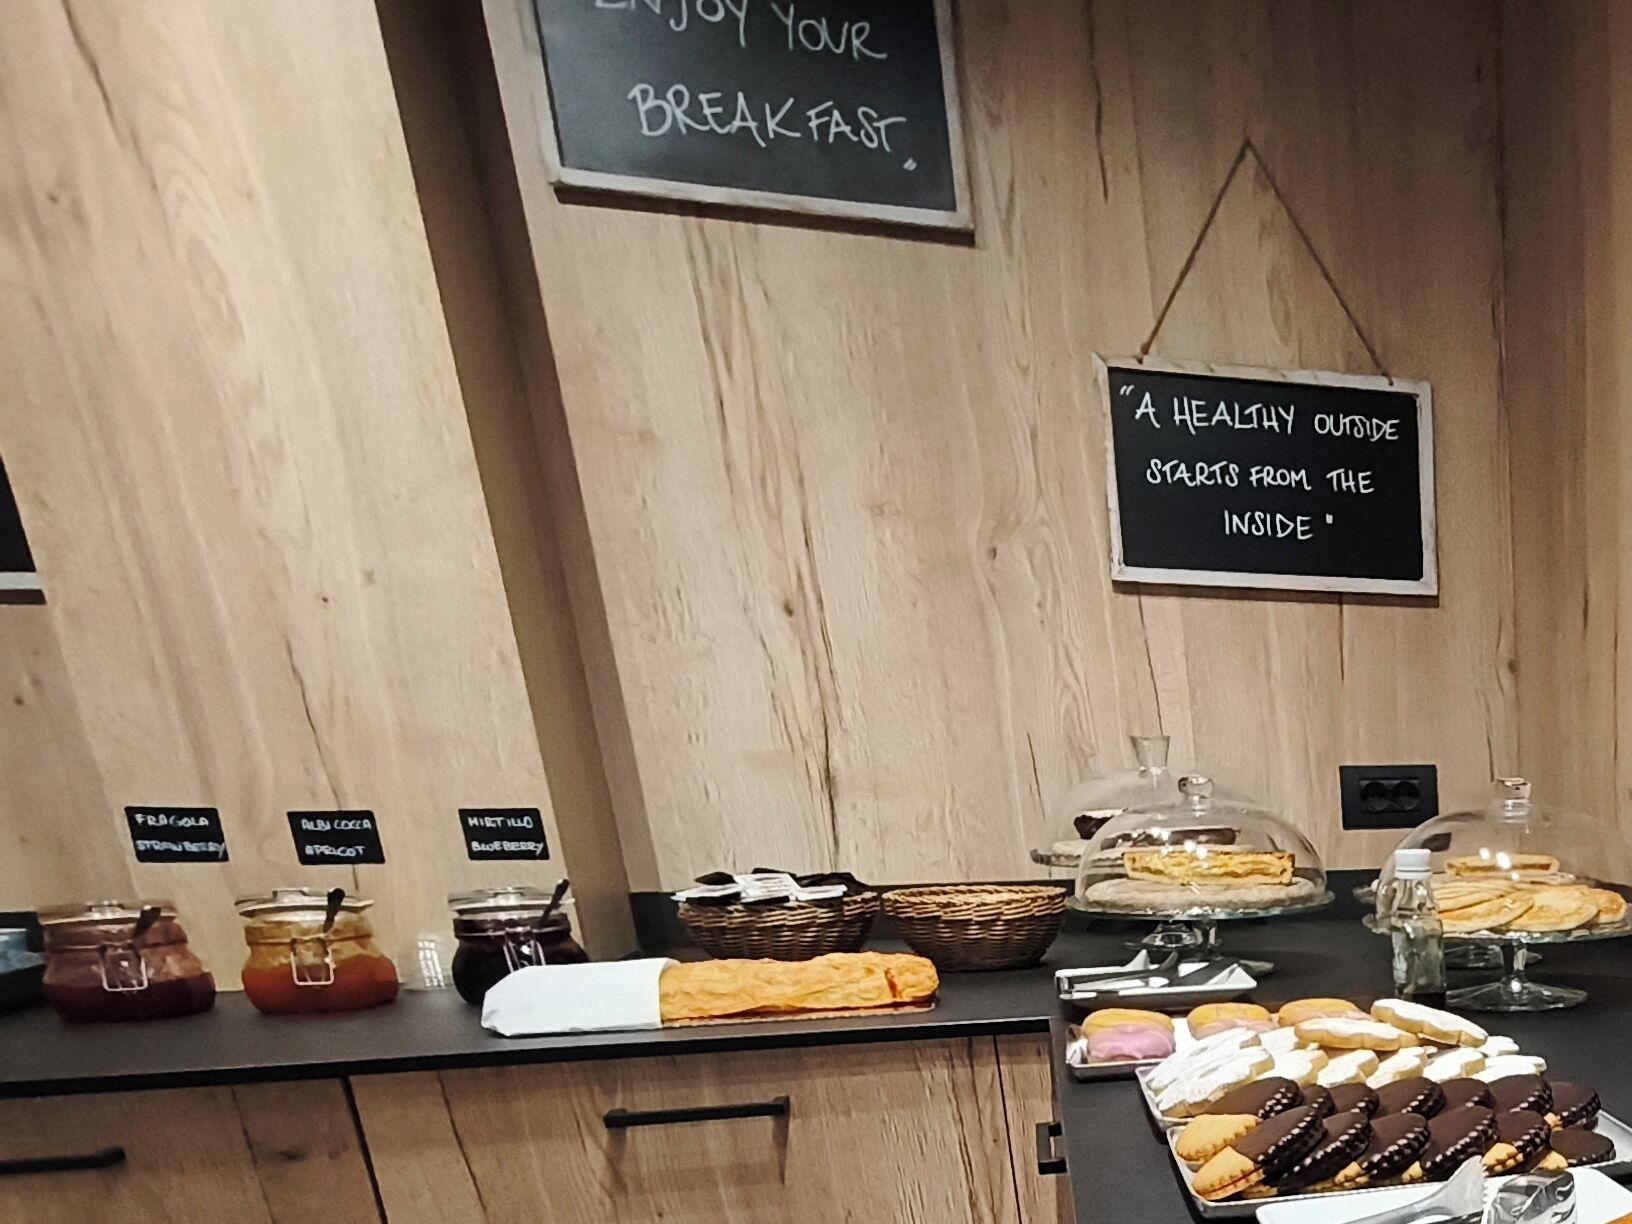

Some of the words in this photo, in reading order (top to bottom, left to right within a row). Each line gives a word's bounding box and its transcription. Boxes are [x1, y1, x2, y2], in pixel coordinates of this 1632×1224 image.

[595, 0, 747, 47] JOY
[772, 4, 887, 60] YOUR
[1173, 396, 1295, 435] HEALTHY
[1146, 458, 1239, 488] STARTS
[1250, 465, 1312, 491] FROM
[1326, 469, 1375, 493] THE
[134, 813, 209, 828] FRAGOLA
[304, 844, 366, 857] APRICOT
[470, 840, 545, 856] BLUEBERRY
